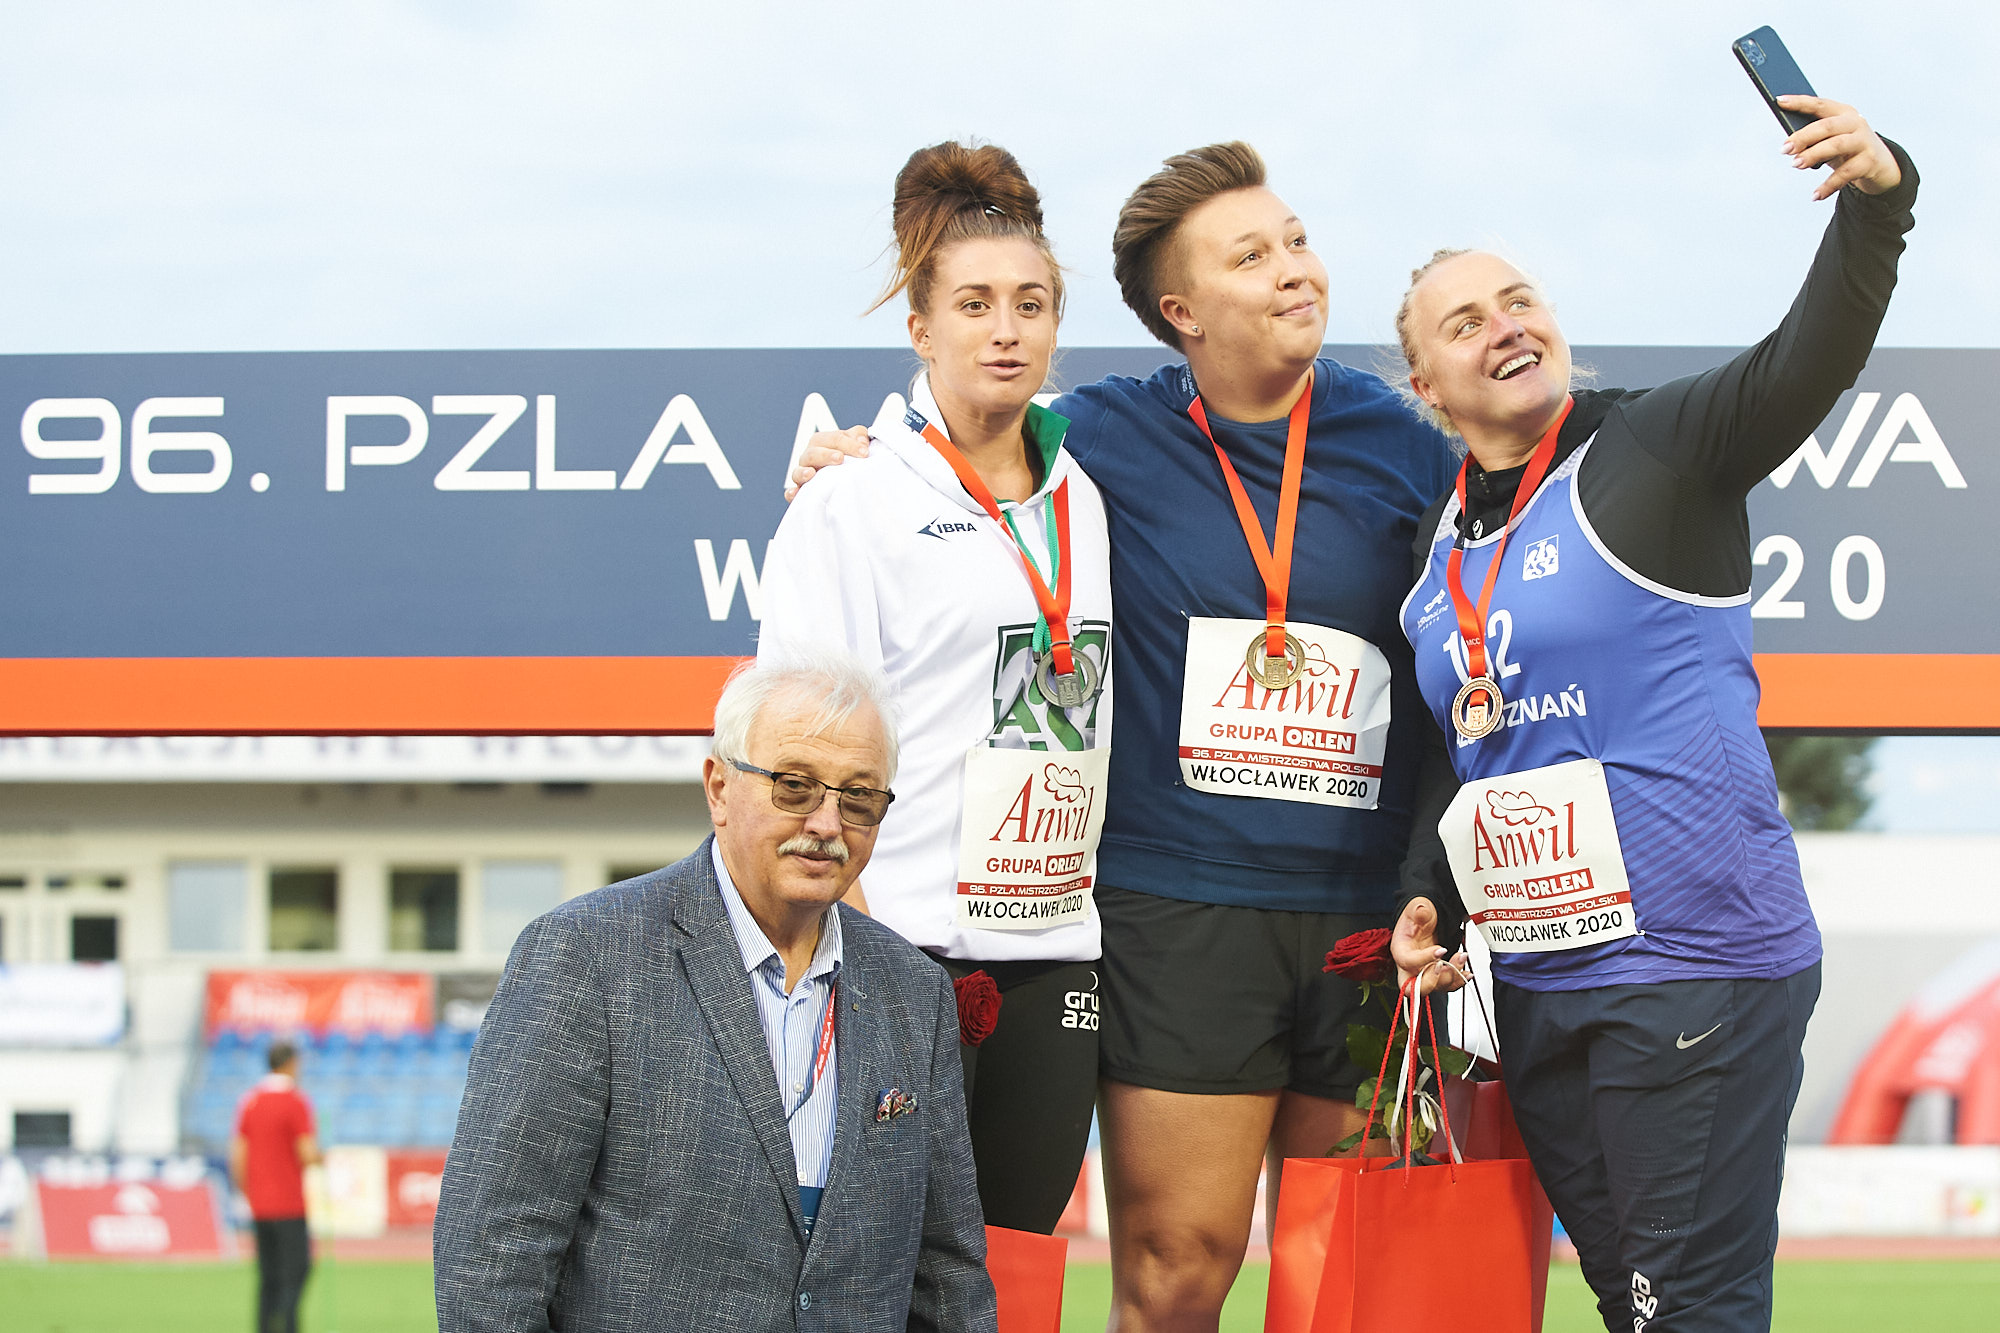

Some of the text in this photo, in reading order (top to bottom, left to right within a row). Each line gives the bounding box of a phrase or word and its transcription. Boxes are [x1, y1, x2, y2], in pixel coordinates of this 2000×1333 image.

[20, 397, 271, 495] 96.
[325, 393, 743, 492] PZLA
[937, 521, 977, 535] IBRA
[1212, 659, 1360, 720] Anwil
[1209, 723, 1353, 751] GRUPA ORLEN
[1191, 749, 1369, 776] 96. PZLA MISTRZOSTWA POLSKI
[1191, 764, 1368, 799] WŁOCŁAWEK 2020
[988, 772, 1095, 843] Anwil
[1473, 801, 1580, 873] Anwil
[986, 854, 1084, 875] GRUPA ORLEN
[969, 884, 987, 894] 96.
[989, 886, 1017, 895] PZLA
[1483, 871, 1589, 899] GRUPA ORLEN
[967, 894, 1083, 919] WŁOCŁAWEK 2020
[1496, 911, 1515, 920] PZLA
[1514, 904, 1575, 920] MISTRZOSTWA
[1576, 895, 1618, 912] POLSKI
[1488, 910, 1623, 943] WŁOCŁAWEK 2020
